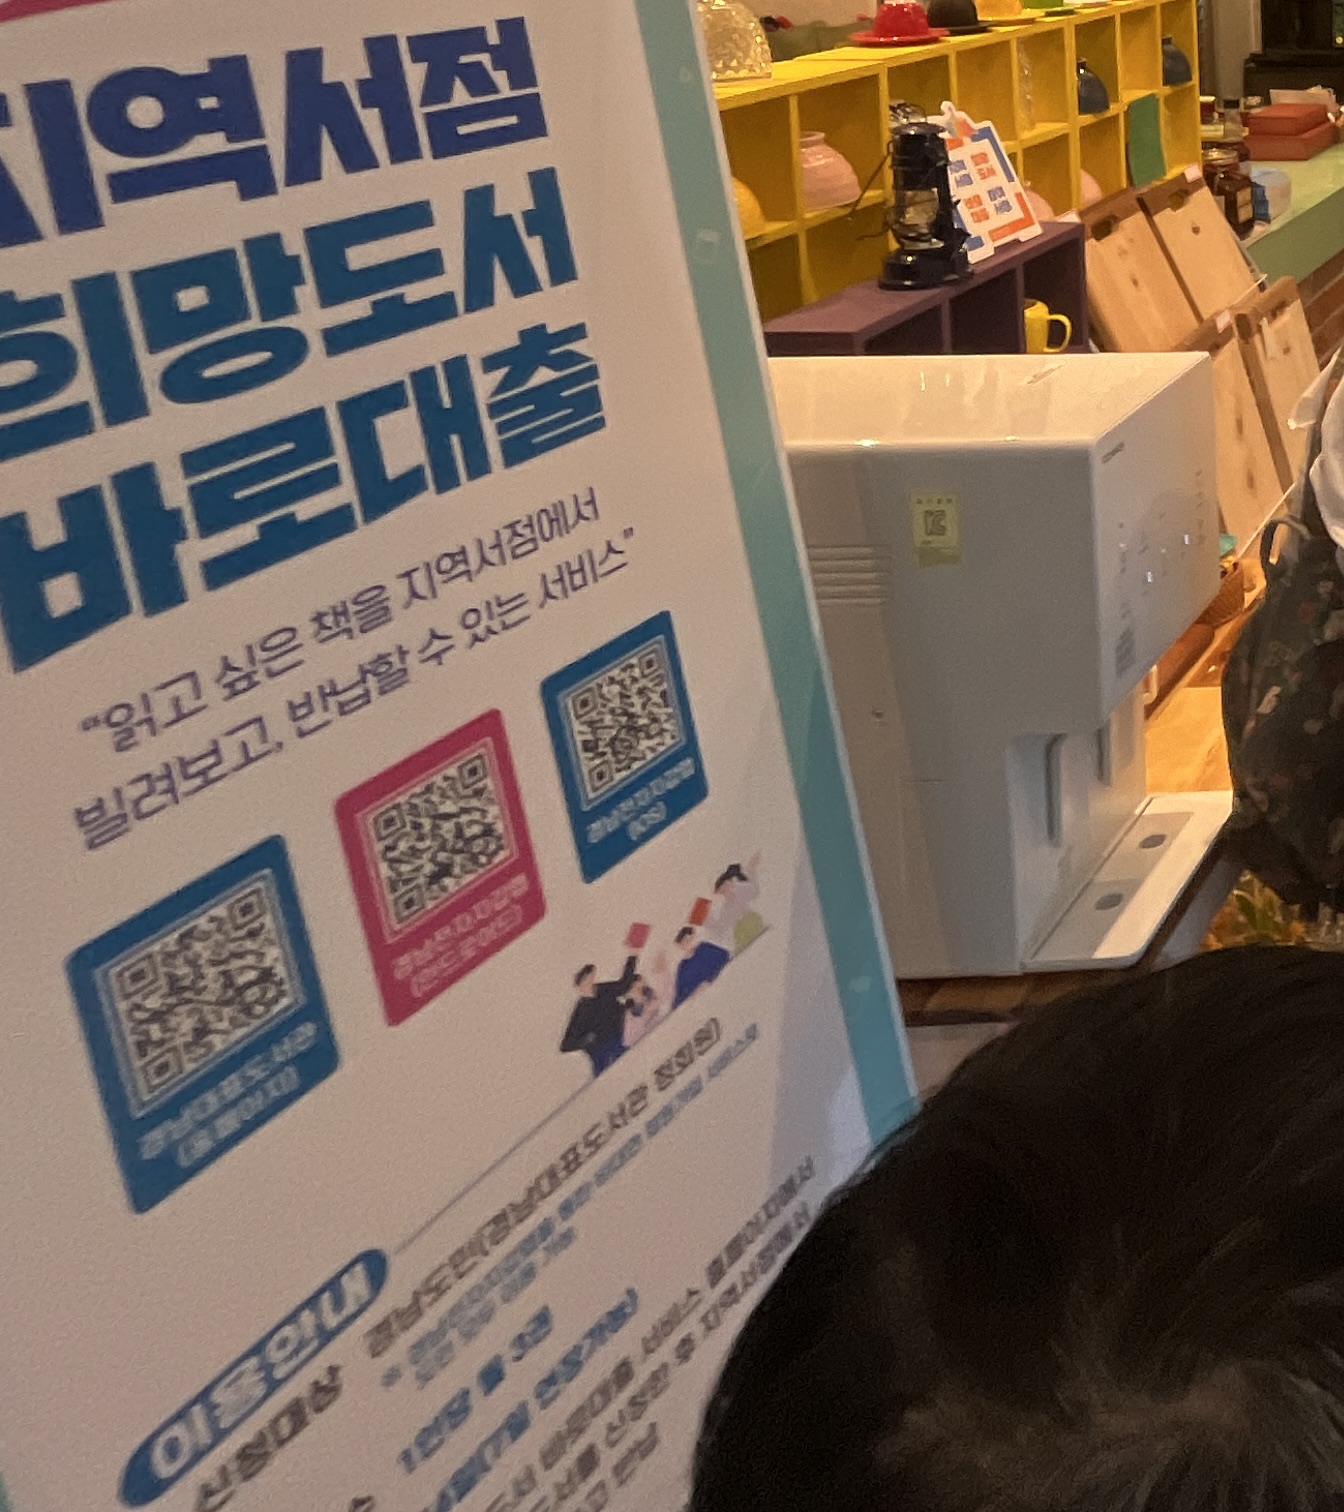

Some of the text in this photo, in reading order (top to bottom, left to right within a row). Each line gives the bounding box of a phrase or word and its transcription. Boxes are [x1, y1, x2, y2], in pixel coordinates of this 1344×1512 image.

[0, 16, 548, 249] 지역서점
[0, 167, 578, 462] 희망도서
[0, 322, 607, 673] 바로대출
[214, 626, 305, 695] 싶은
[311, 583, 394, 646] 책을
[396, 486, 600, 609] 지역서점에서
[287, 642, 409, 738] 반납할
[420, 626, 457, 667] 수
[461, 590, 531, 649] 있는
[151, 1259, 371, 1481] 이용안내
[196, 1363, 344, 1512] 신청대상
